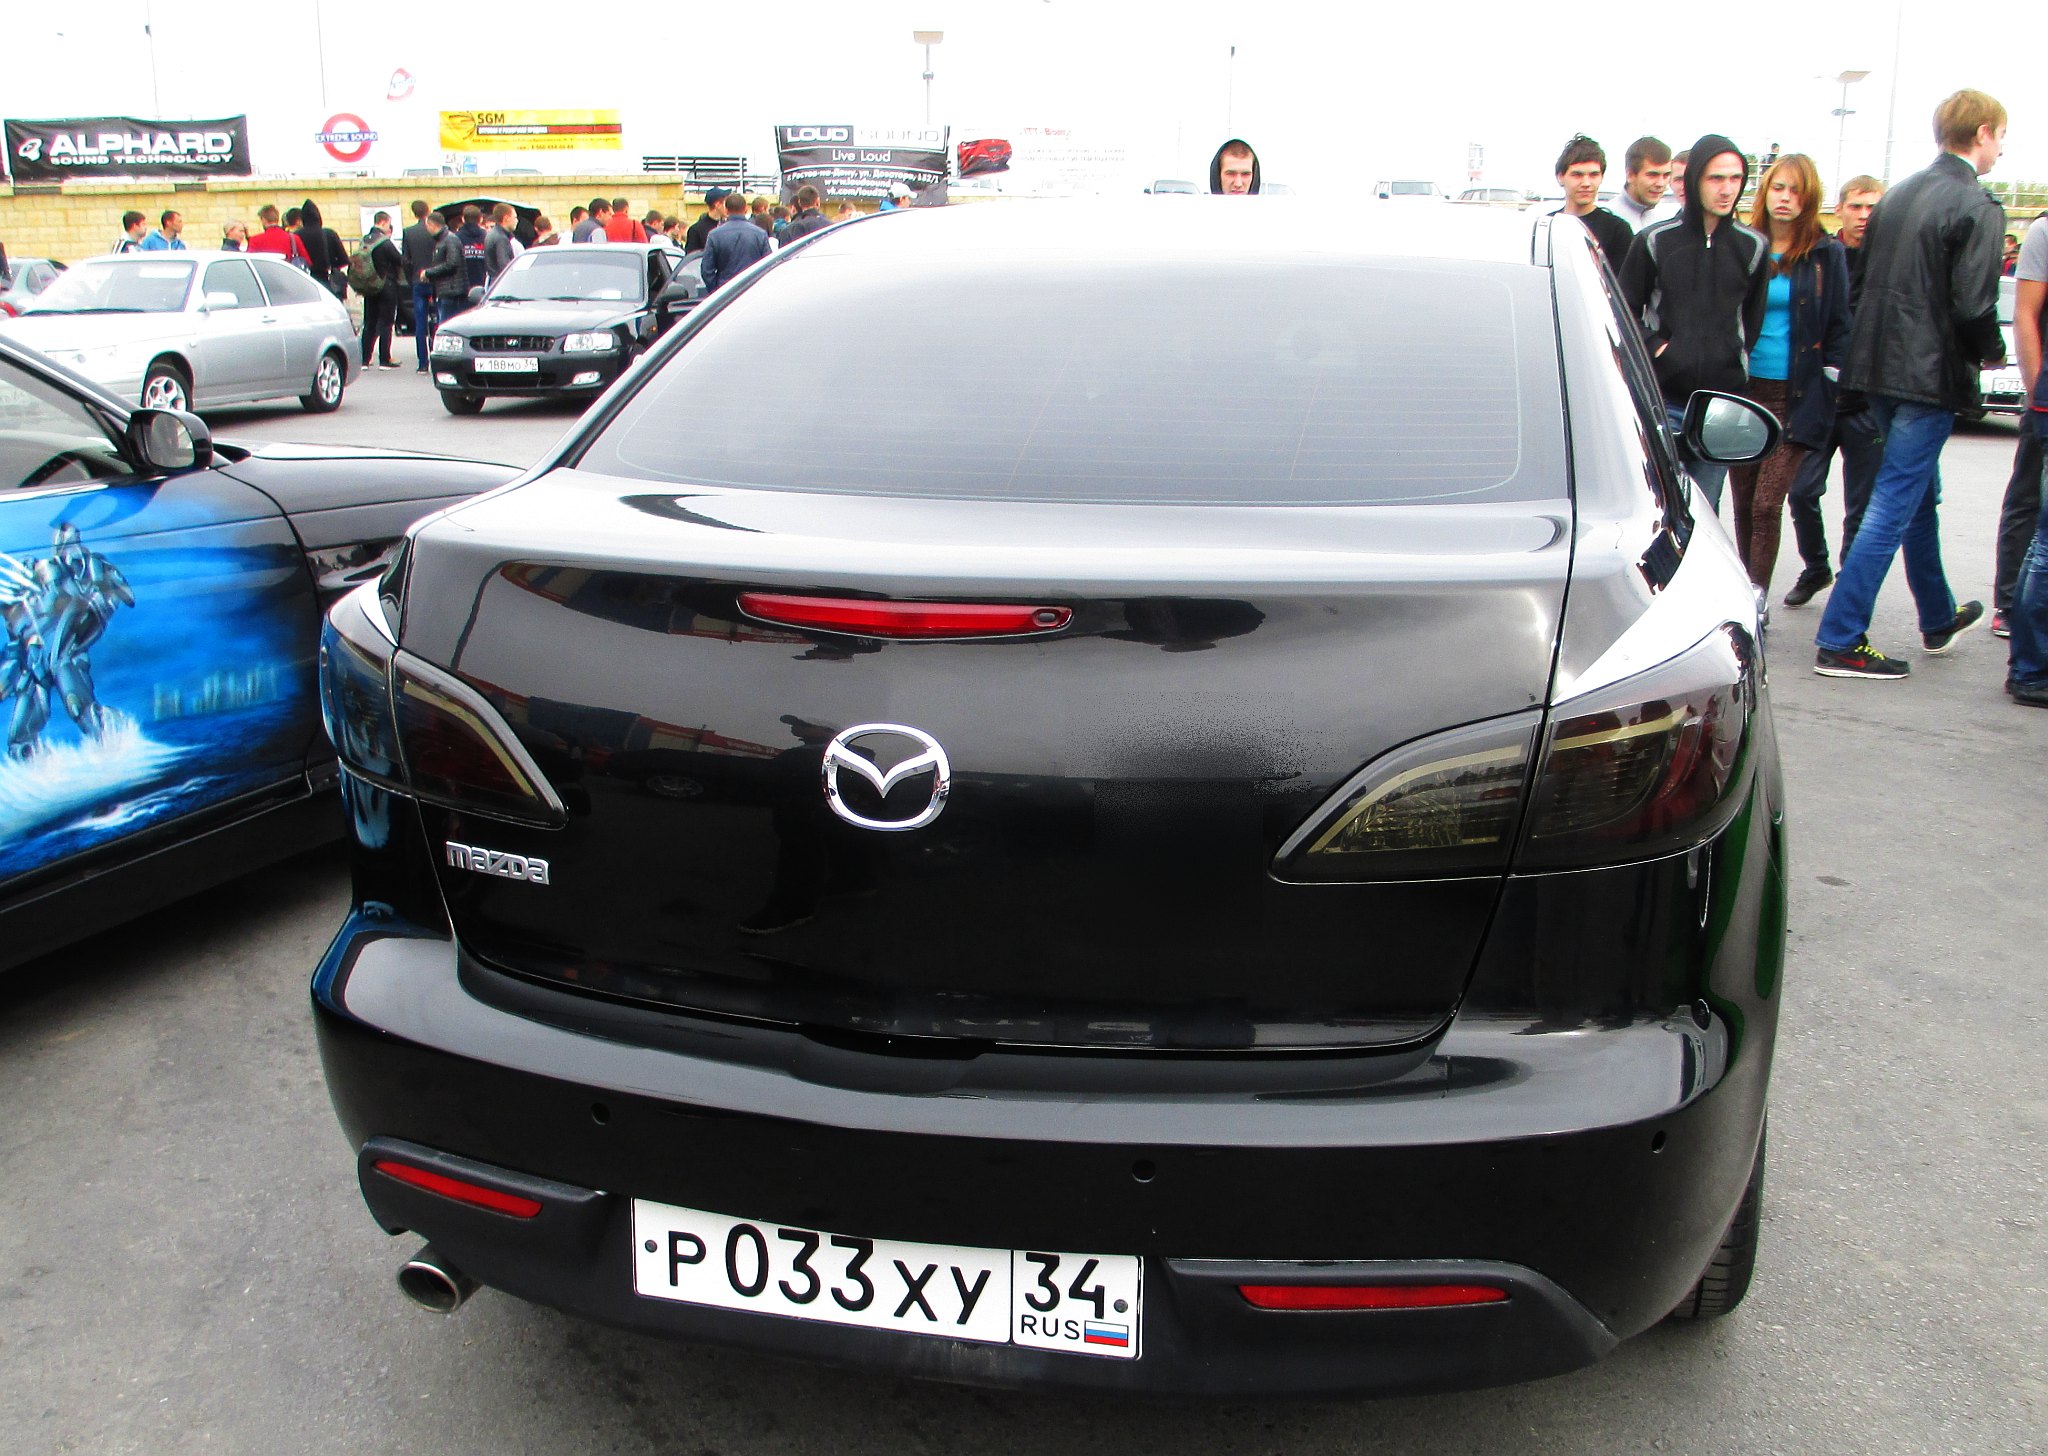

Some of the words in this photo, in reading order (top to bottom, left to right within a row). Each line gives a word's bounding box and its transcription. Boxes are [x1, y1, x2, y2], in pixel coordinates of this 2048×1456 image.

[477, 113, 505, 124] SGM
[351, 133, 378, 141] SOUND
[786, 127, 849, 143] LOUD
[49, 132, 233, 156] ALPHARD
[50, 155, 110, 166] SOUND
[113, 153, 234, 165] TECHNOLOGY
[832, 149, 857, 161] Live
[860, 150, 891, 162] Loud
[446, 841, 550, 885] mazda
[1023, 1252, 1106, 1320] 34
[1020, 1313, 1080, 1340] RUS
